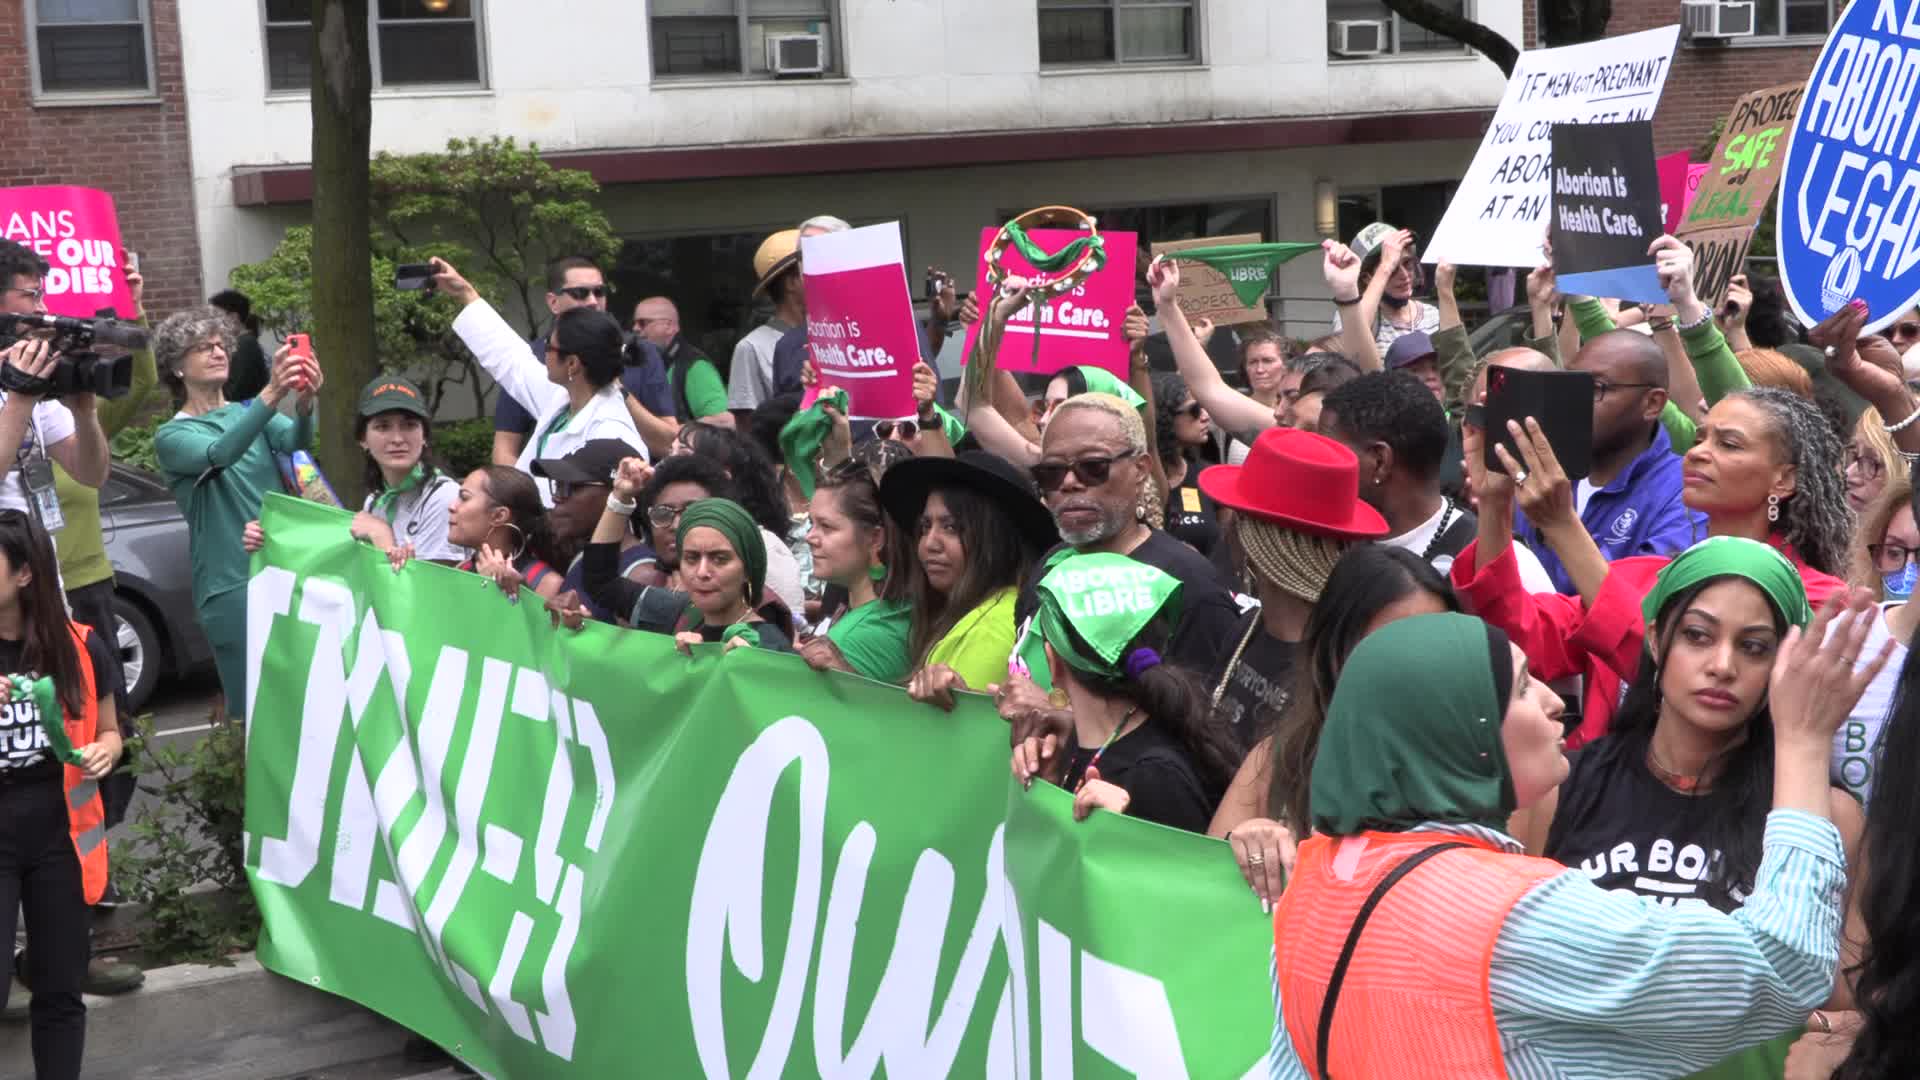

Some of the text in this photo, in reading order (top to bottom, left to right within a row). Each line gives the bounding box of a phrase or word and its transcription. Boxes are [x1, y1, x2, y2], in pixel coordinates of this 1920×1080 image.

[1543, 71, 1576, 99] MEN
[1592, 56, 1667, 93] PREGNANT
[1729, 88, 1804, 134] PROTEC
[1491, 120, 1523, 145] YOU
[1720, 127, 1784, 175] SAFE
[1490, 154, 1552, 184] ABOR
[1556, 166, 1628, 198] Abortion is
[1480, 194, 1548, 221] AT AN
[1688, 188, 1754, 222] LEGAL
[0, 209, 75, 240] ANS
[1558, 205, 1602, 233] Health
[1602, 207, 1643, 236] Care.
[57, 238, 117, 268] OUR
[44, 266, 113, 295] DIES
[1230, 267, 1268, 283] LIBRE
[845, 315, 861, 338] is
[1058, 301, 1110, 328] Care.
[811, 342, 894, 367] Health Care.
[1068, 586, 1155, 618] LIBRE
[1580, 841, 1640, 880] UR
